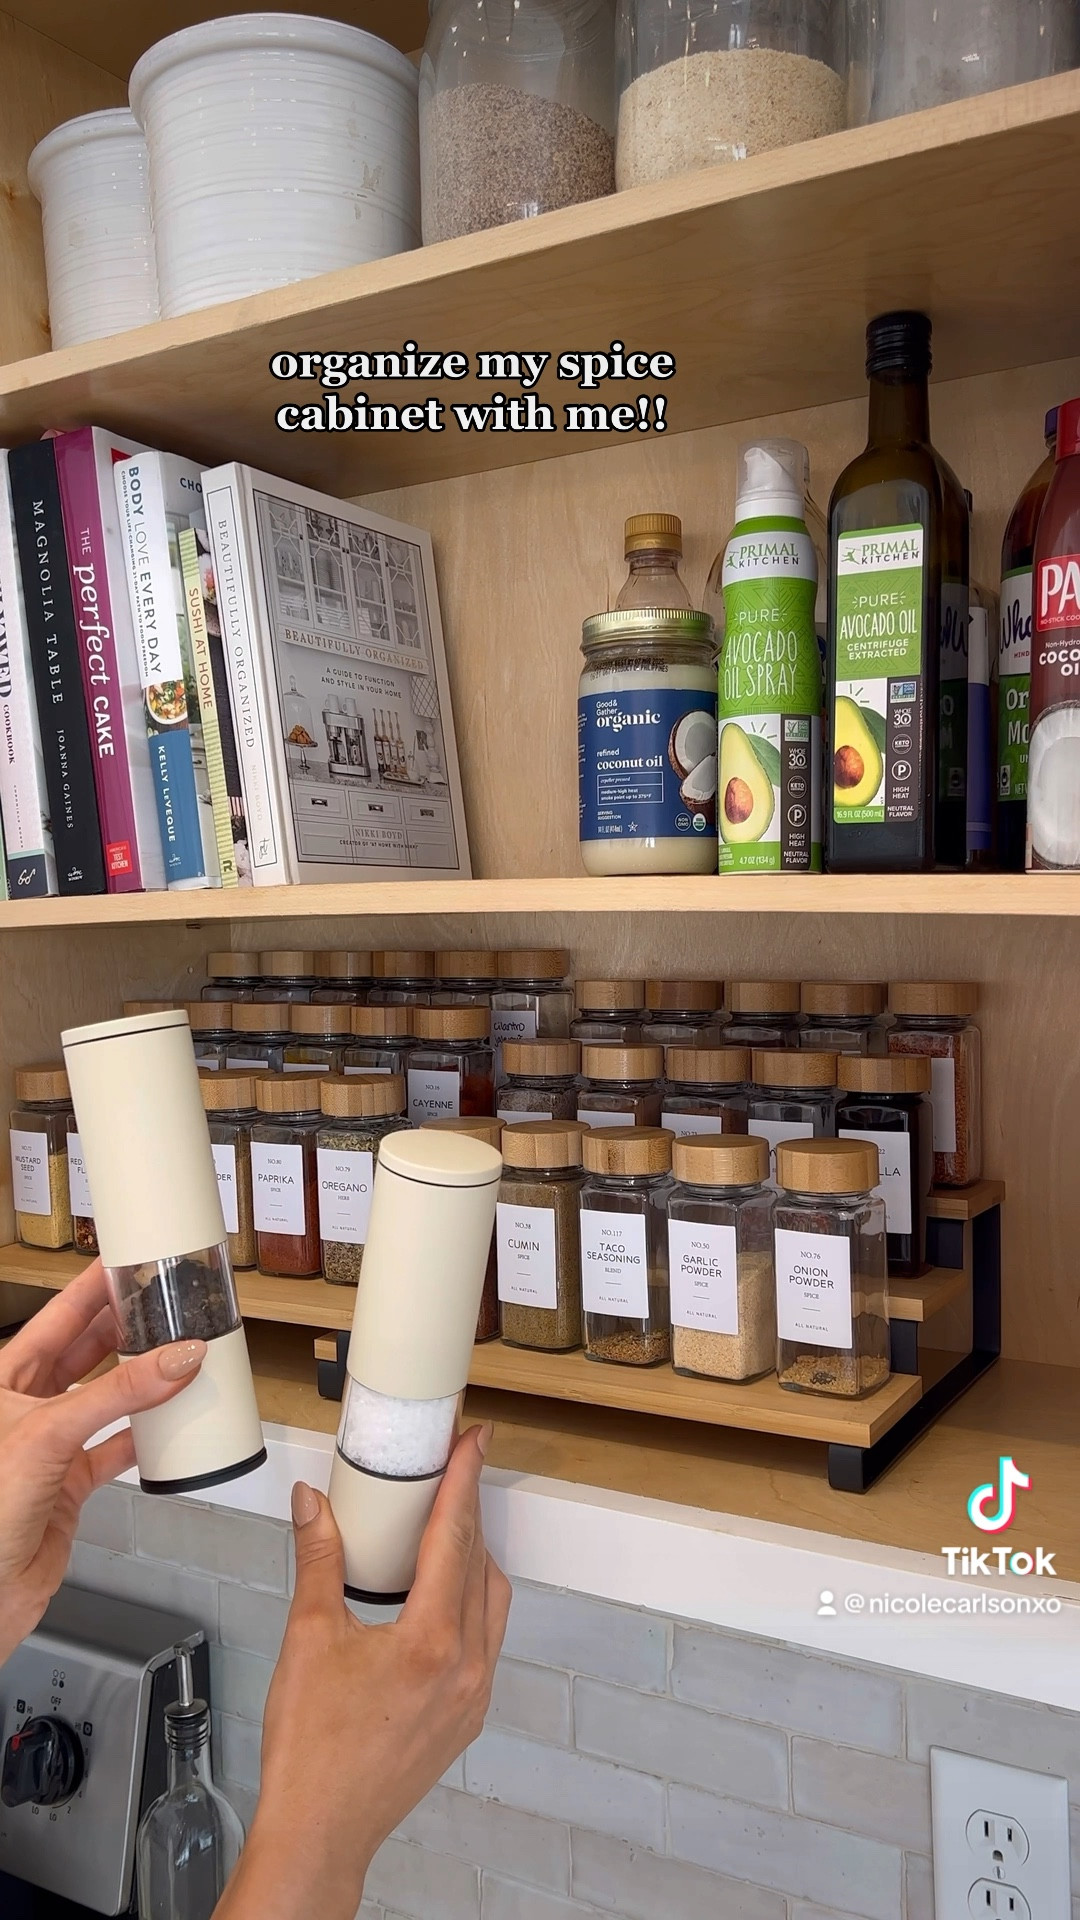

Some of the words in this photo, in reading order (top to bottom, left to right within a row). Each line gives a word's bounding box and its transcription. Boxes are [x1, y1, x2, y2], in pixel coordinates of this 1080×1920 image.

[129, 466, 144, 515] BODY
[80, 528, 92, 556] THE
[134, 521, 150, 566] LOVE
[862, 538, 919, 556] PRIMAL
[739, 542, 798, 560] PRIMAL
[861, 551, 919, 565] KITCHEN
[739, 556, 799, 568] KITCHEN
[33, 500, 55, 622] MAGNOLIA
[46, 633, 64, 704] TABLE
[140, 572, 157, 630] EVERY
[859, 592, 899, 608] PURE
[189, 588, 204, 634] SUSHI
[739, 608, 780, 623] PURE
[73, 563, 111, 687] perfect
[840, 611, 895, 640] AVOCADO
[899, 608, 918, 634] OIL
[218, 520, 241, 638] BEAUTIFULLY
[234, 646, 255, 748] ORGANIZED
[195, 639, 207, 656] AT
[284, 628, 361, 656] BEAUTIFULLY
[365, 649, 425, 670] ORGANIZED
[724, 631, 797, 668] AVOCADO
[847, 639, 909, 652] CENTRIFUGE
[147, 637, 162, 673] DAY
[848, 648, 907, 660] EXTRACTED
[332, 668, 352, 679] GUIDE
[354, 673, 363, 681] TO
[364, 675, 395, 687] FUNCTION
[724, 667, 742, 700] OIL
[745, 664, 797, 697] SPRAY
[198, 662, 214, 710] HOME
[321, 676, 335, 685] AND
[337, 679, 356, 689] STYLE
[366, 685, 383, 694] YOUR
[385, 690, 402, 698] HOME
[596, 708, 617, 717] Gather
[93, 696, 115, 758] CAKE
[596, 709, 661, 733] organic
[3, 704, 15, 764] COOKBOOK
[596, 748, 620, 757] refined
[158, 745, 169, 782] KELLY
[597, 758, 643, 770] coconut
[645, 755, 663, 768] oil
[56, 729, 69, 778] JOANNA
[63, 783, 74, 829] GAINES
[355, 828, 379, 838] NIKKI
[382, 831, 403, 840] BOYD
[783, 850, 809, 858] NEUTRAL
[412, 1099, 453, 1110] CAYENNE
[15, 1156, 41, 1164] MUSTARD
[70, 1158, 83, 1166] RED
[20, 1164, 35, 1172] SEED
[257, 1173, 295, 1185] PAPRIKA
[321, 1181, 368, 1193] OREGANO
[601, 1229, 623, 1237] NO.117
[508, 1238, 540, 1251] CUMIN
[600, 1243, 626, 1253] TACO
[691, 1241, 710, 1250] NO.50
[586, 1251, 641, 1265] SEASONING
[682, 1254, 719, 1267] GARLIC
[800, 1251, 821, 1260] NO.76
[680, 1264, 722, 1278] POWDER
[793, 1265, 829, 1278] ONION
[789, 1275, 834, 1289] POWDER
[803, 1292, 820, 1300] SPICE
[696, 1311, 717, 1319] NATURAL
[805, 1324, 829, 1332] NATURAL
[51, 1695, 62, 1706] OFF
[31, 1806, 39, 1815] LO
[49, 1812, 57, 1821] LO
[67, 1806, 72, 1814] 2
